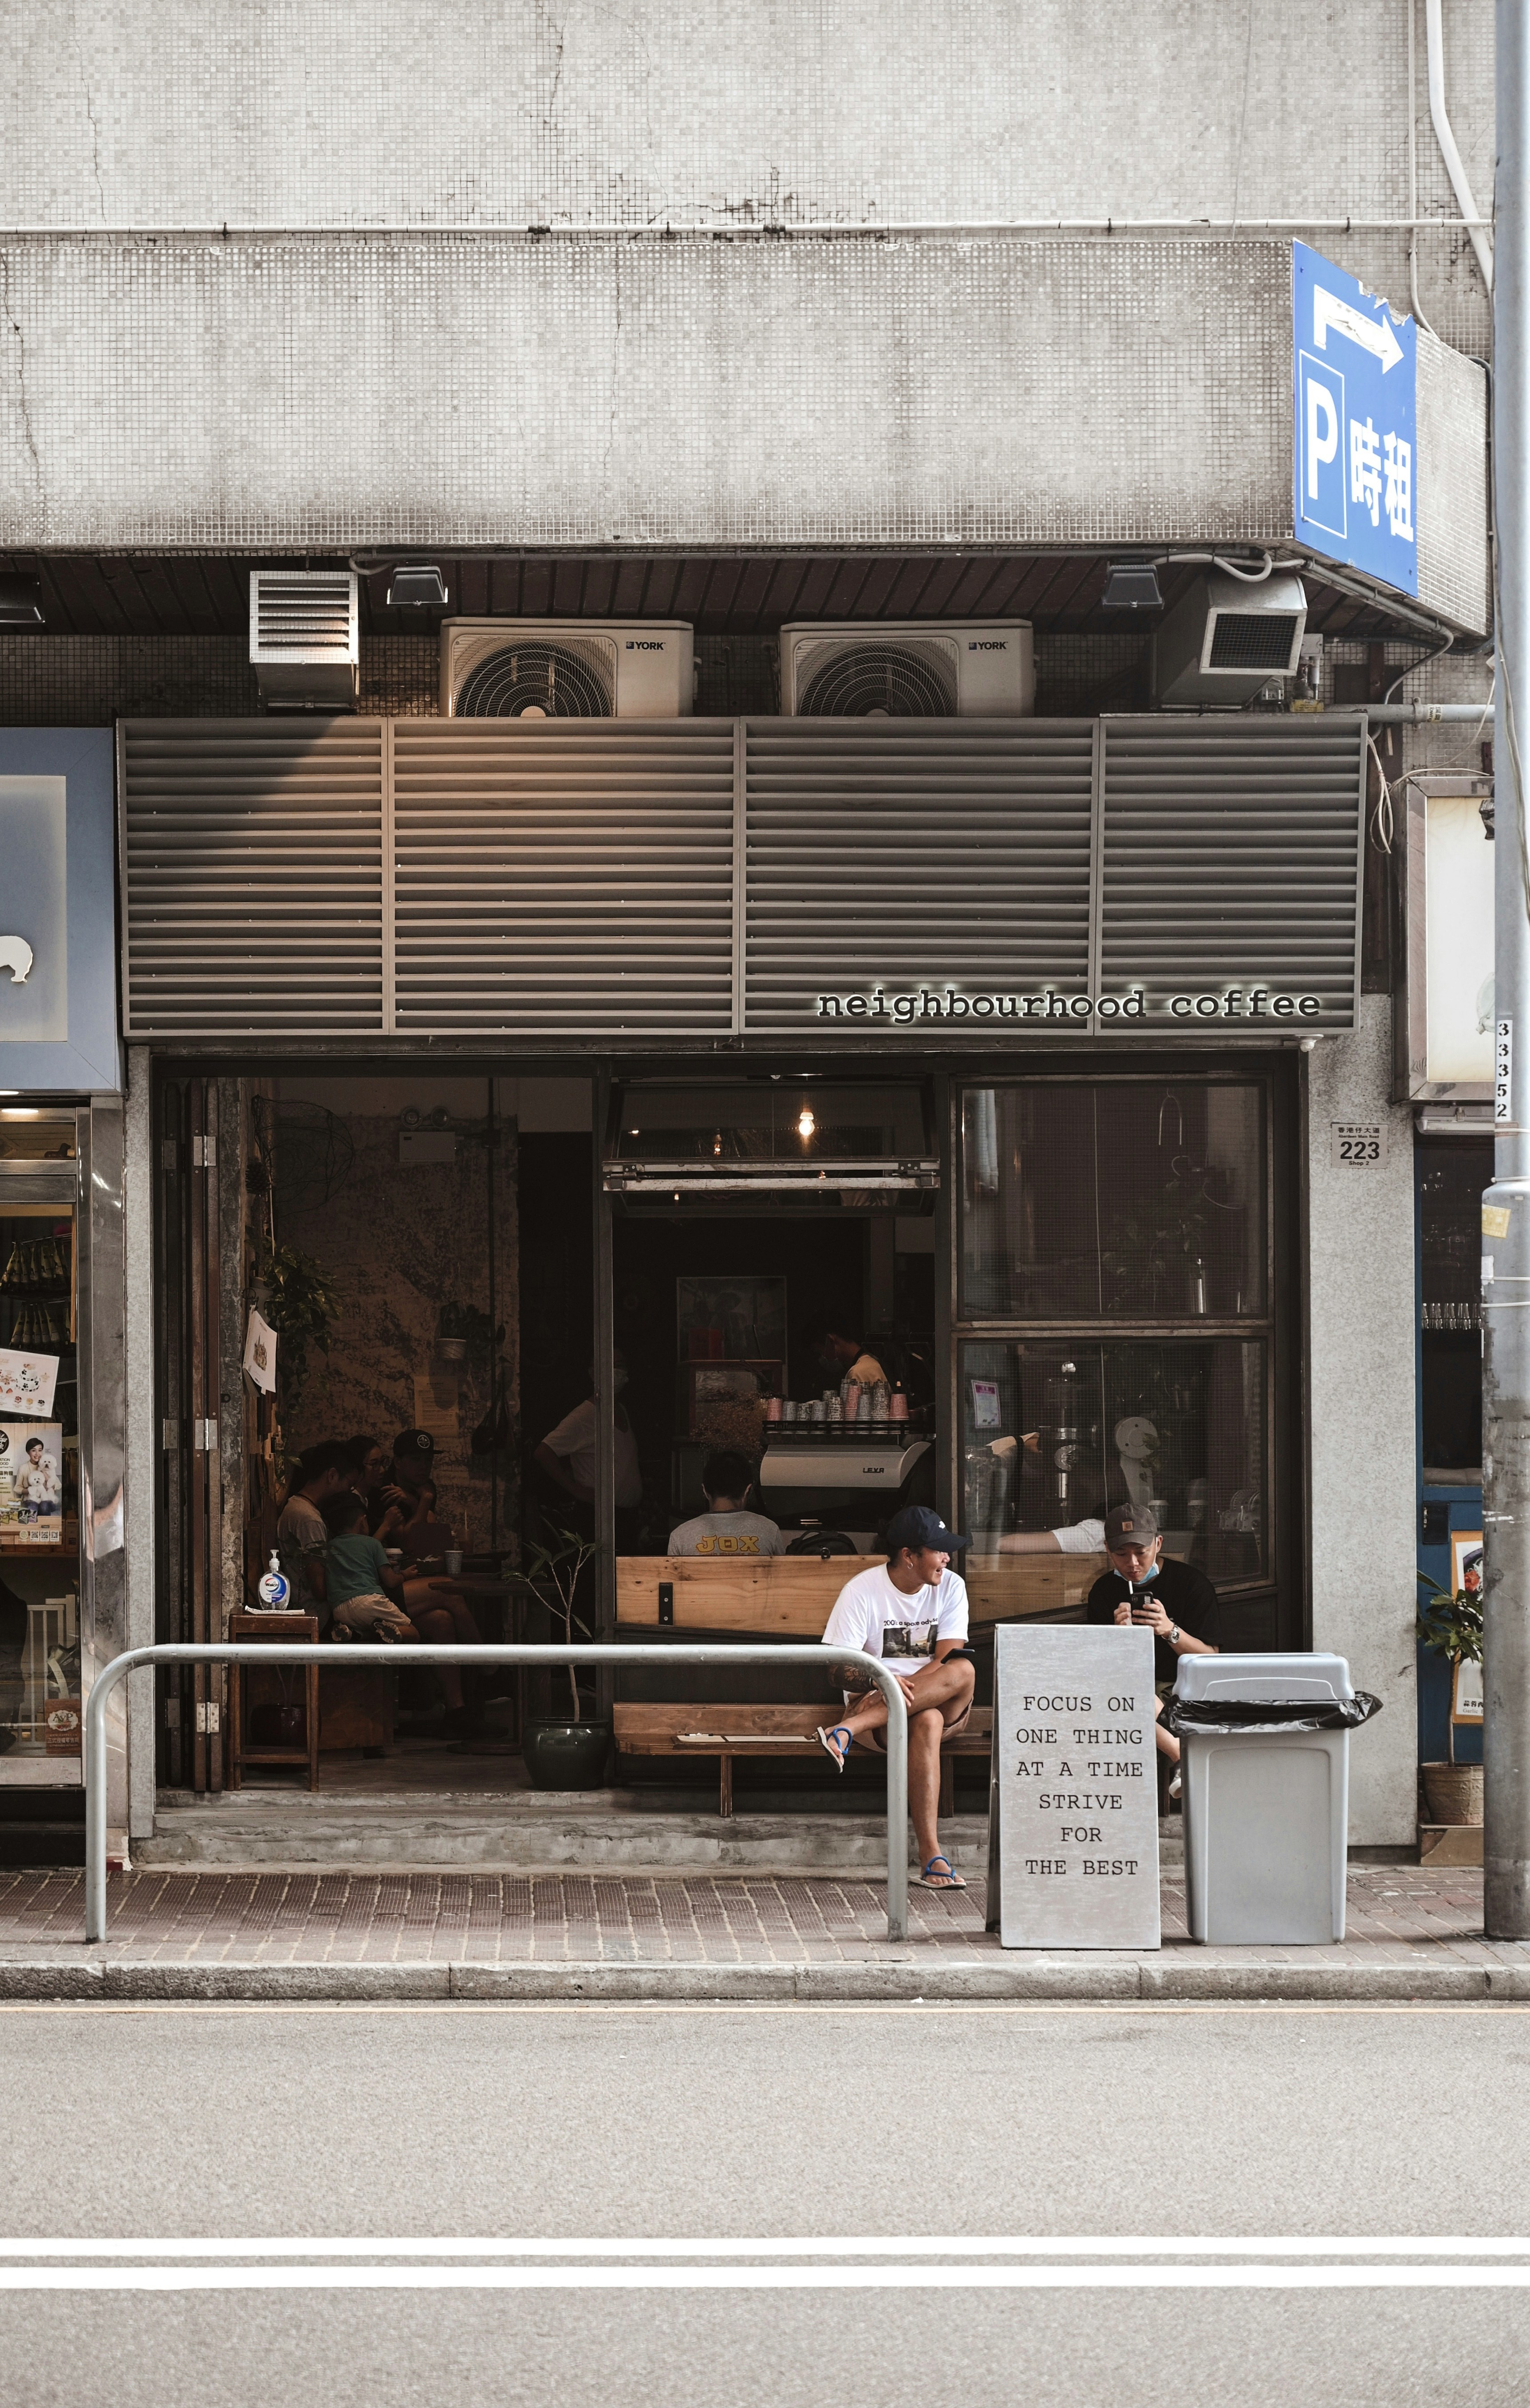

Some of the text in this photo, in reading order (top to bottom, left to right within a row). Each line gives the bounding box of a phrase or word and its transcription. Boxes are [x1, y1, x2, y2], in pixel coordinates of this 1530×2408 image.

[1307, 378, 1338, 500] P
[1350, 417, 1414, 542] 時租
[635, 641, 664, 650] YORK
[978, 641, 1006, 650] YORK
[817, 988, 1321, 1024] neighbourhood coffee
[1497, 1023, 1509, 1117] 33352
[1340, 1141, 1380, 1160] 223
[696, 1535, 760, 1552] JOX
[1023, 1696, 1135, 1712] FOCUS ON
[1016, 1728, 1143, 1744] ONE THING
[1016, 1761, 1143, 1777] AT A TIME
[1039, 1794, 1122, 1809] STRIVE
[1061, 1827, 1103, 1842] FOR
[1025, 1860, 1138, 1875] THE BEST
